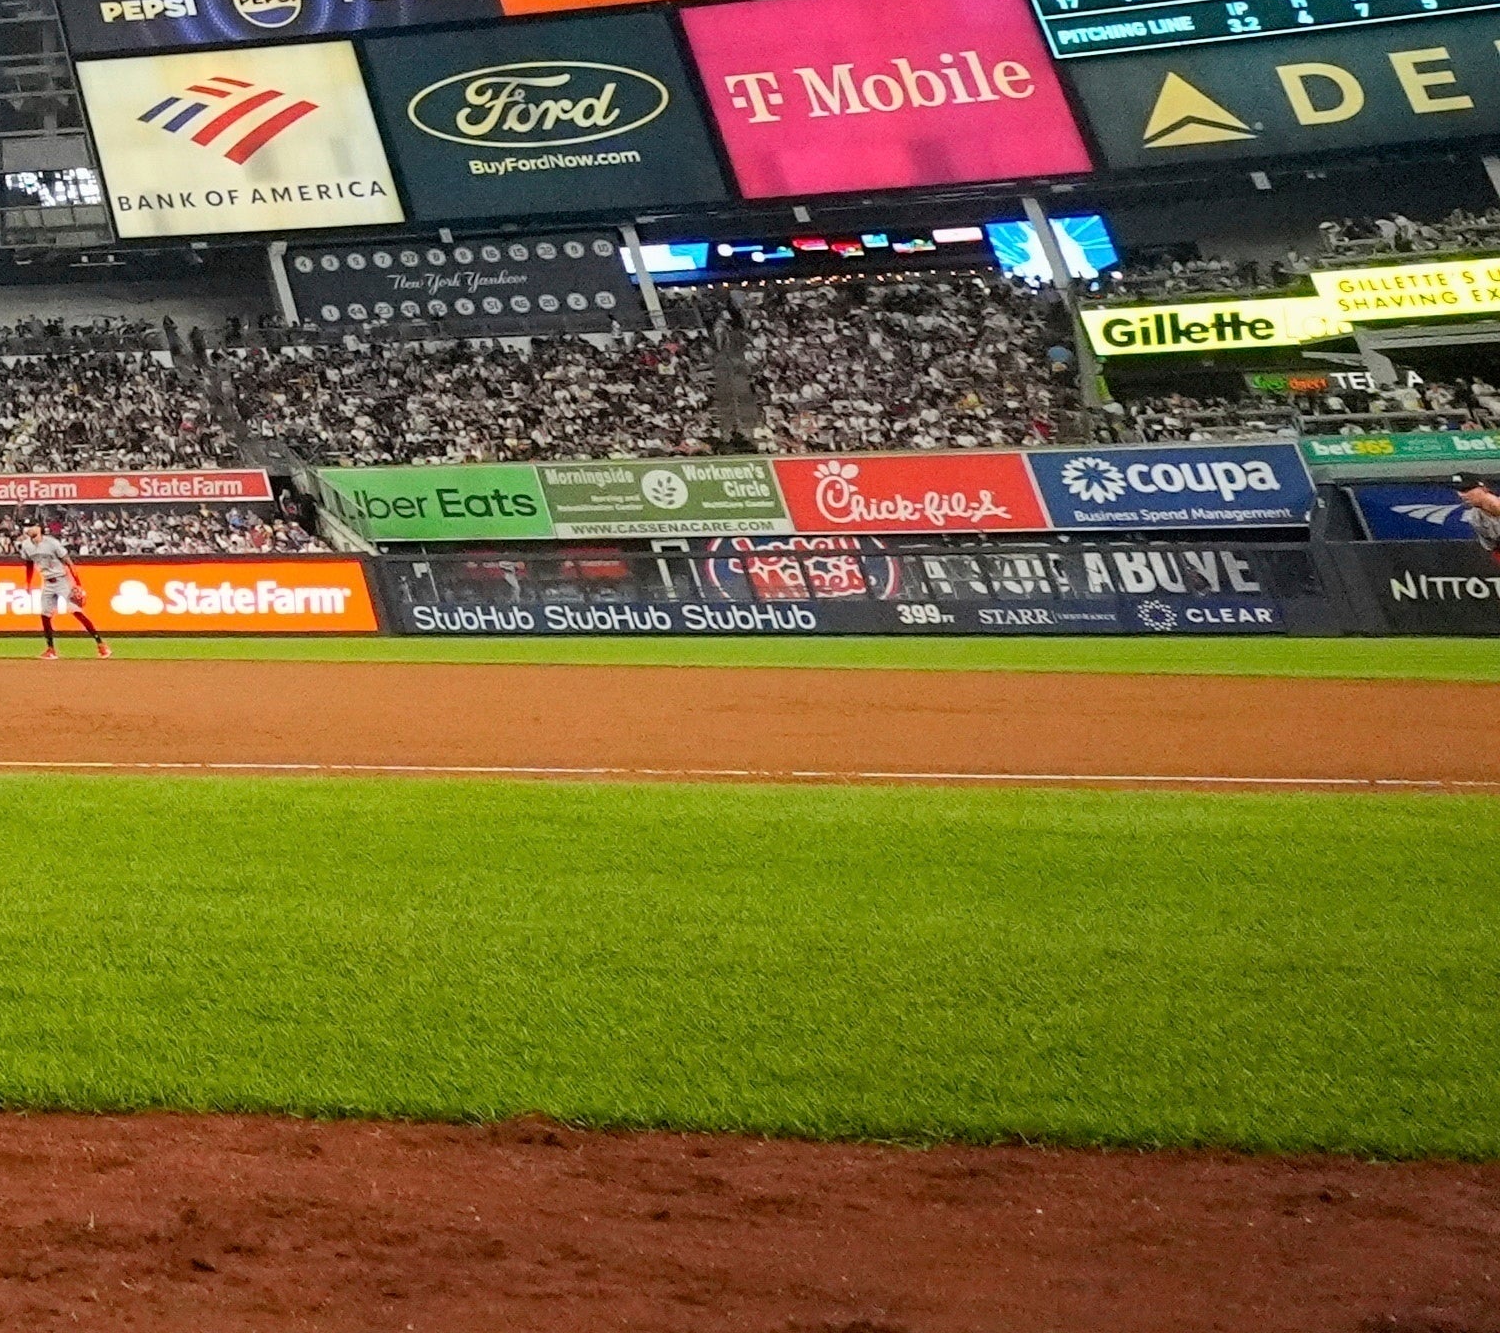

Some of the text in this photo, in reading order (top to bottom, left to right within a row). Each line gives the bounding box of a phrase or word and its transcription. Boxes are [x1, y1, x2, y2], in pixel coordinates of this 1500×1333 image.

[1225, 0, 1249, 17] IP
[1056, 15, 1196, 46] PITCHING LINE
[1227, 17, 1262, 33] 3.2
[800, 52, 1036, 119] Mobile
[1275, 38, 1500, 126] DE
[454, 71, 622, 137] Ford
[468, 147, 641, 176] BuyFordNow.com
[117, 180, 388, 214] BANK OF AMERICA
[386, 273, 424, 290] New
[424, 271, 461, 296] York
[1338, 291, 1459, 312] SHAVING
[1102, 311, 1275, 348] Gillette
[1311, 439, 1395, 456] bet365
[545, 467, 635, 487] Morningside
[681, 462, 765, 482] Workmen's
[1126, 458, 1281, 501] coupa
[723, 480, 771, 498] Circle
[815, 473, 1012, 527] Chick-fil-A
[436, 487, 538, 519] Eats
[1074, 506, 1294, 524] Business Spend Management
[571, 520, 775, 535] WWW.CASSENACARE.COM
[411, 604, 536, 632] StubHub
[544, 604, 673, 632] StubHub
[680, 603, 817, 631] StubHub
[897, 603, 942, 625] 399
[977, 608, 1052, 625] STARR
[1185, 608, 1274, 624] CLEAR
